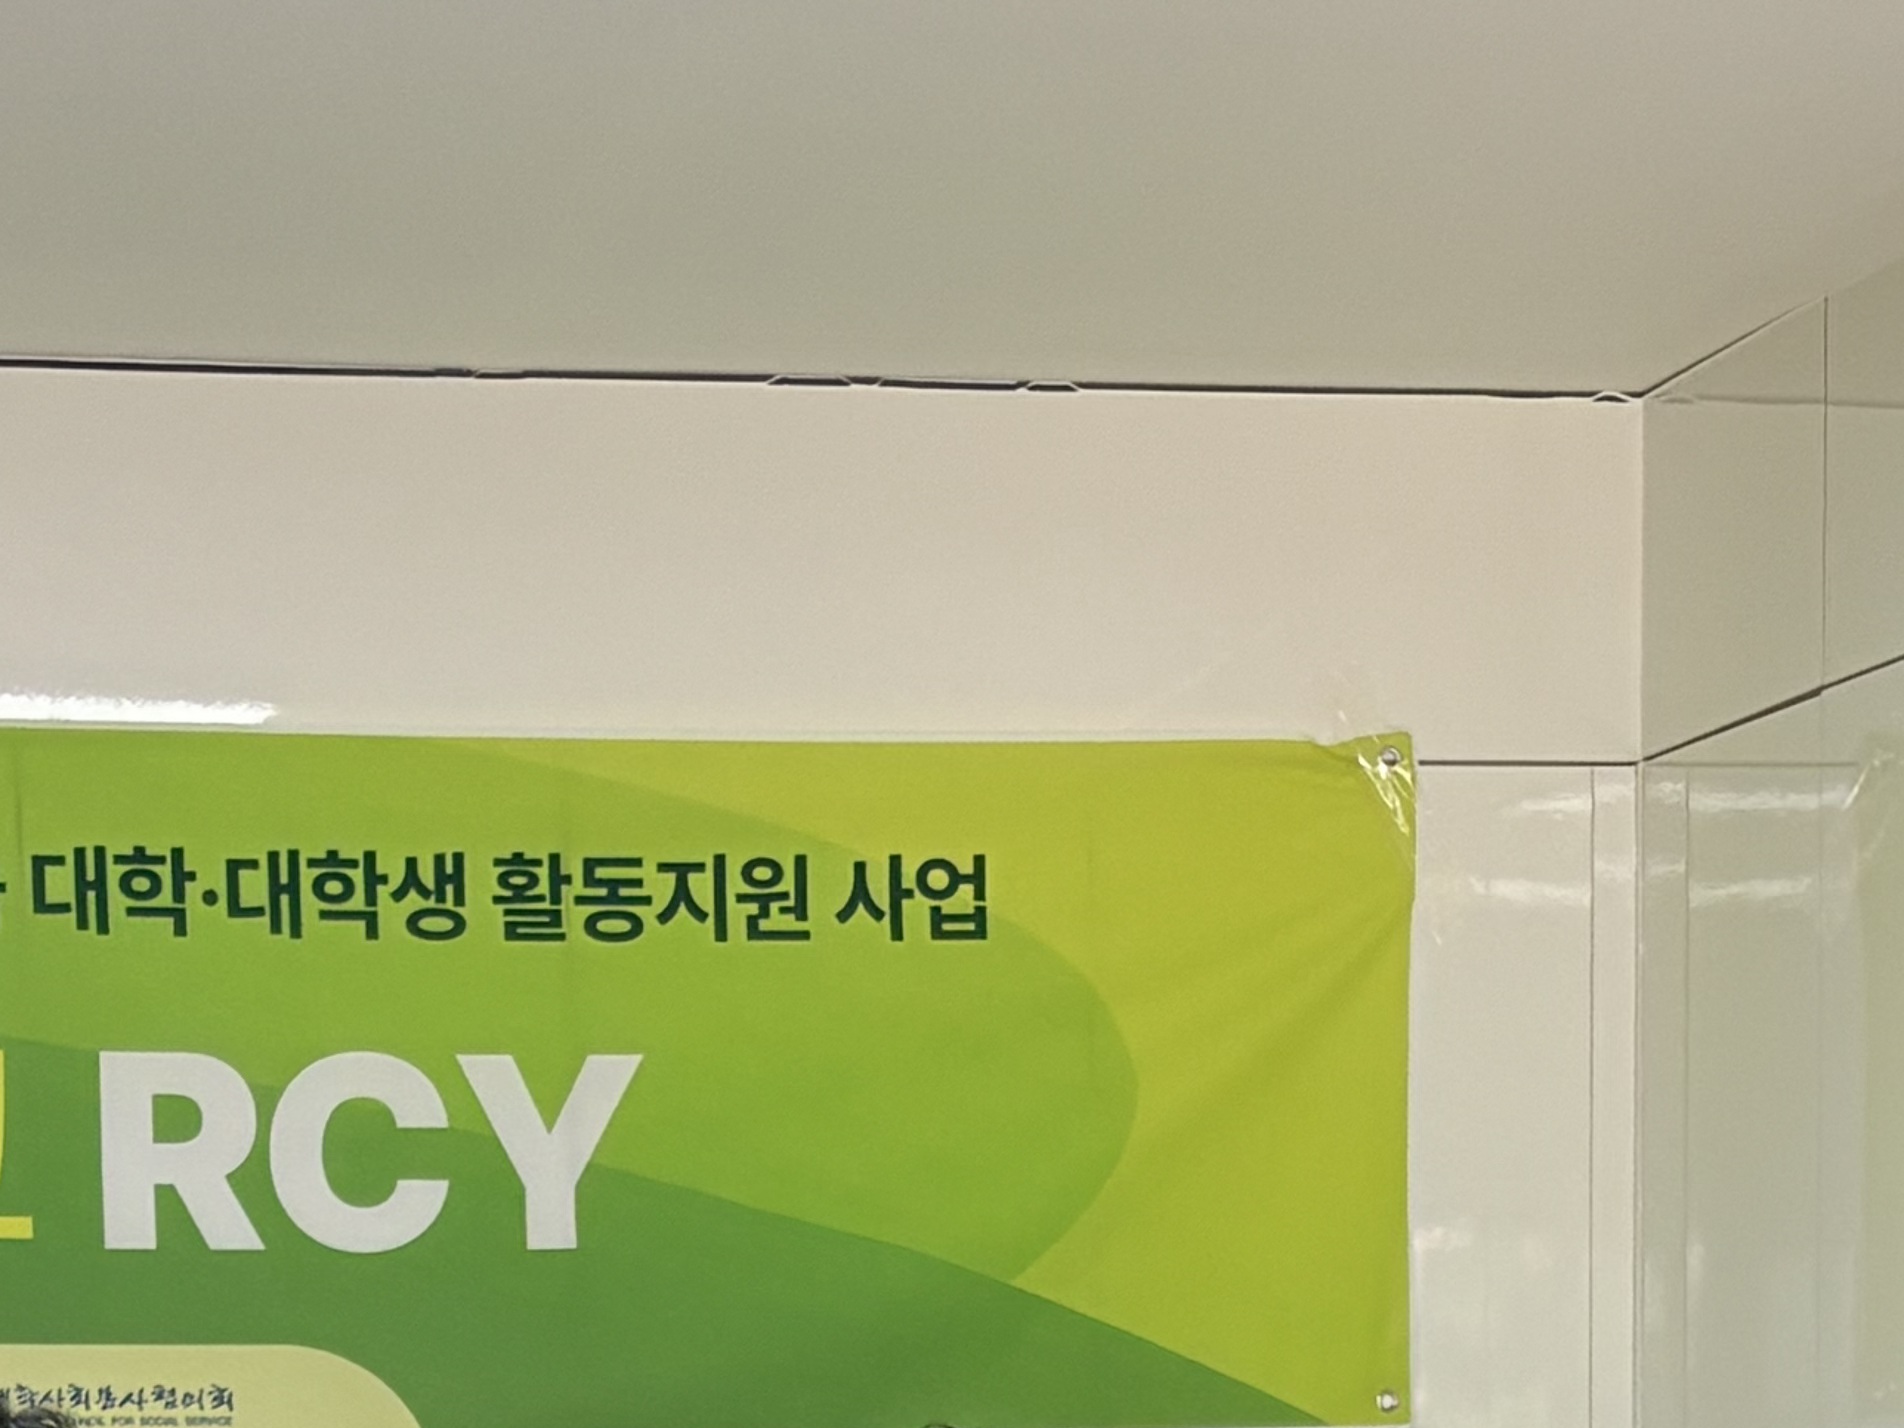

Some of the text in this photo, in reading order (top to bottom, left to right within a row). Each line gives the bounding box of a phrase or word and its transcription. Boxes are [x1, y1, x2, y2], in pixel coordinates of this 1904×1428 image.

[30, 843, 468, 942] 대학·대학생
[491, 850, 813, 945] 활동지원
[834, 852, 990, 943] 사업
[98, 1050, 645, 1254] RCY
